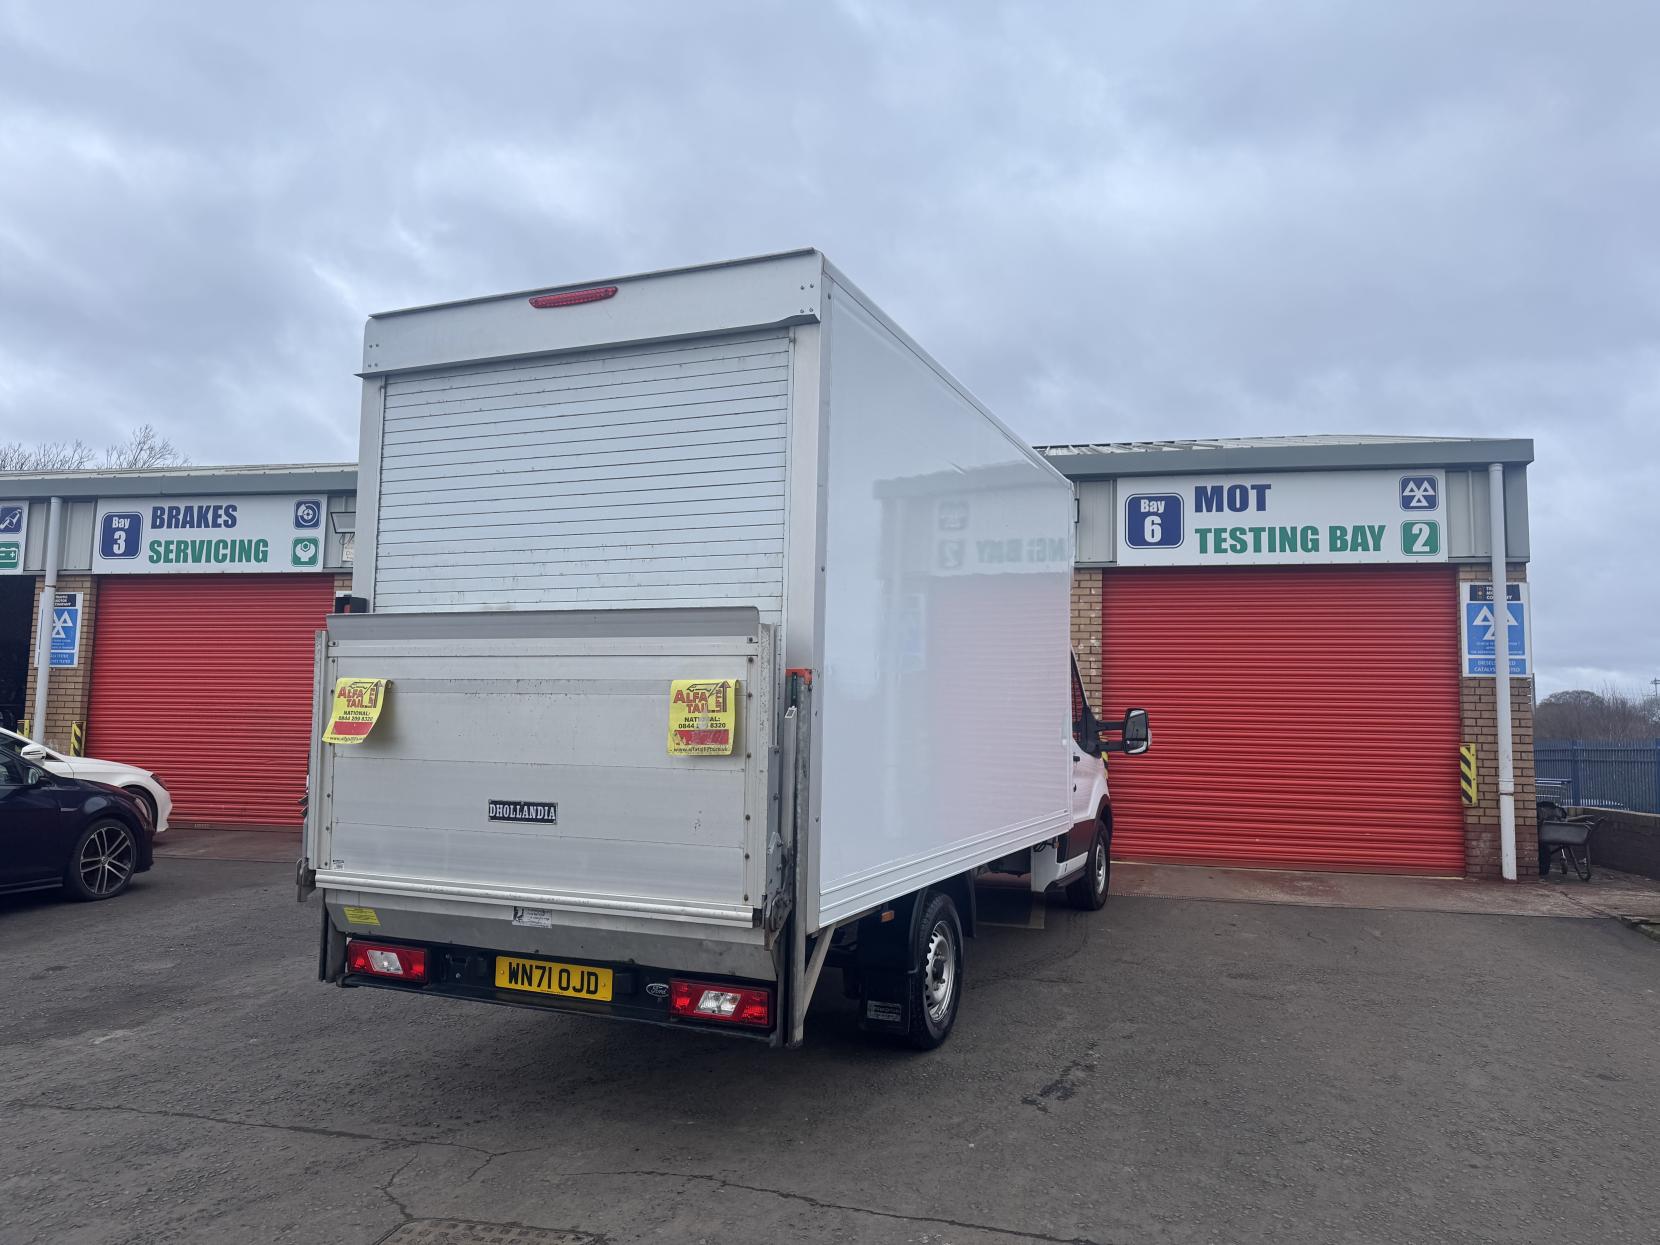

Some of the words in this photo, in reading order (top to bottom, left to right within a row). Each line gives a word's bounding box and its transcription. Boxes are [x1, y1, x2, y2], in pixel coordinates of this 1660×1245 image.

[1140, 499, 1165, 513] Bay
[1194, 484, 1271, 513] MOT
[112, 517, 130, 528] Bay
[150, 504, 237, 529] BRAKES
[1144, 515, 1162, 543] 6
[113, 531, 126, 554] 3
[1195, 526, 1320, 554] TESTING
[1328, 525, 1386, 552] BAY
[1411, 523, 1430, 552] 2
[148, 538, 269, 564] SERVICING
[337, 687, 364, 699] ALFA
[673, 689, 708, 704] ALFA
[489, 804, 556, 819] DHOLLANDIA
[508, 961, 552, 989] WN71
[558, 968, 599, 995] OJD
